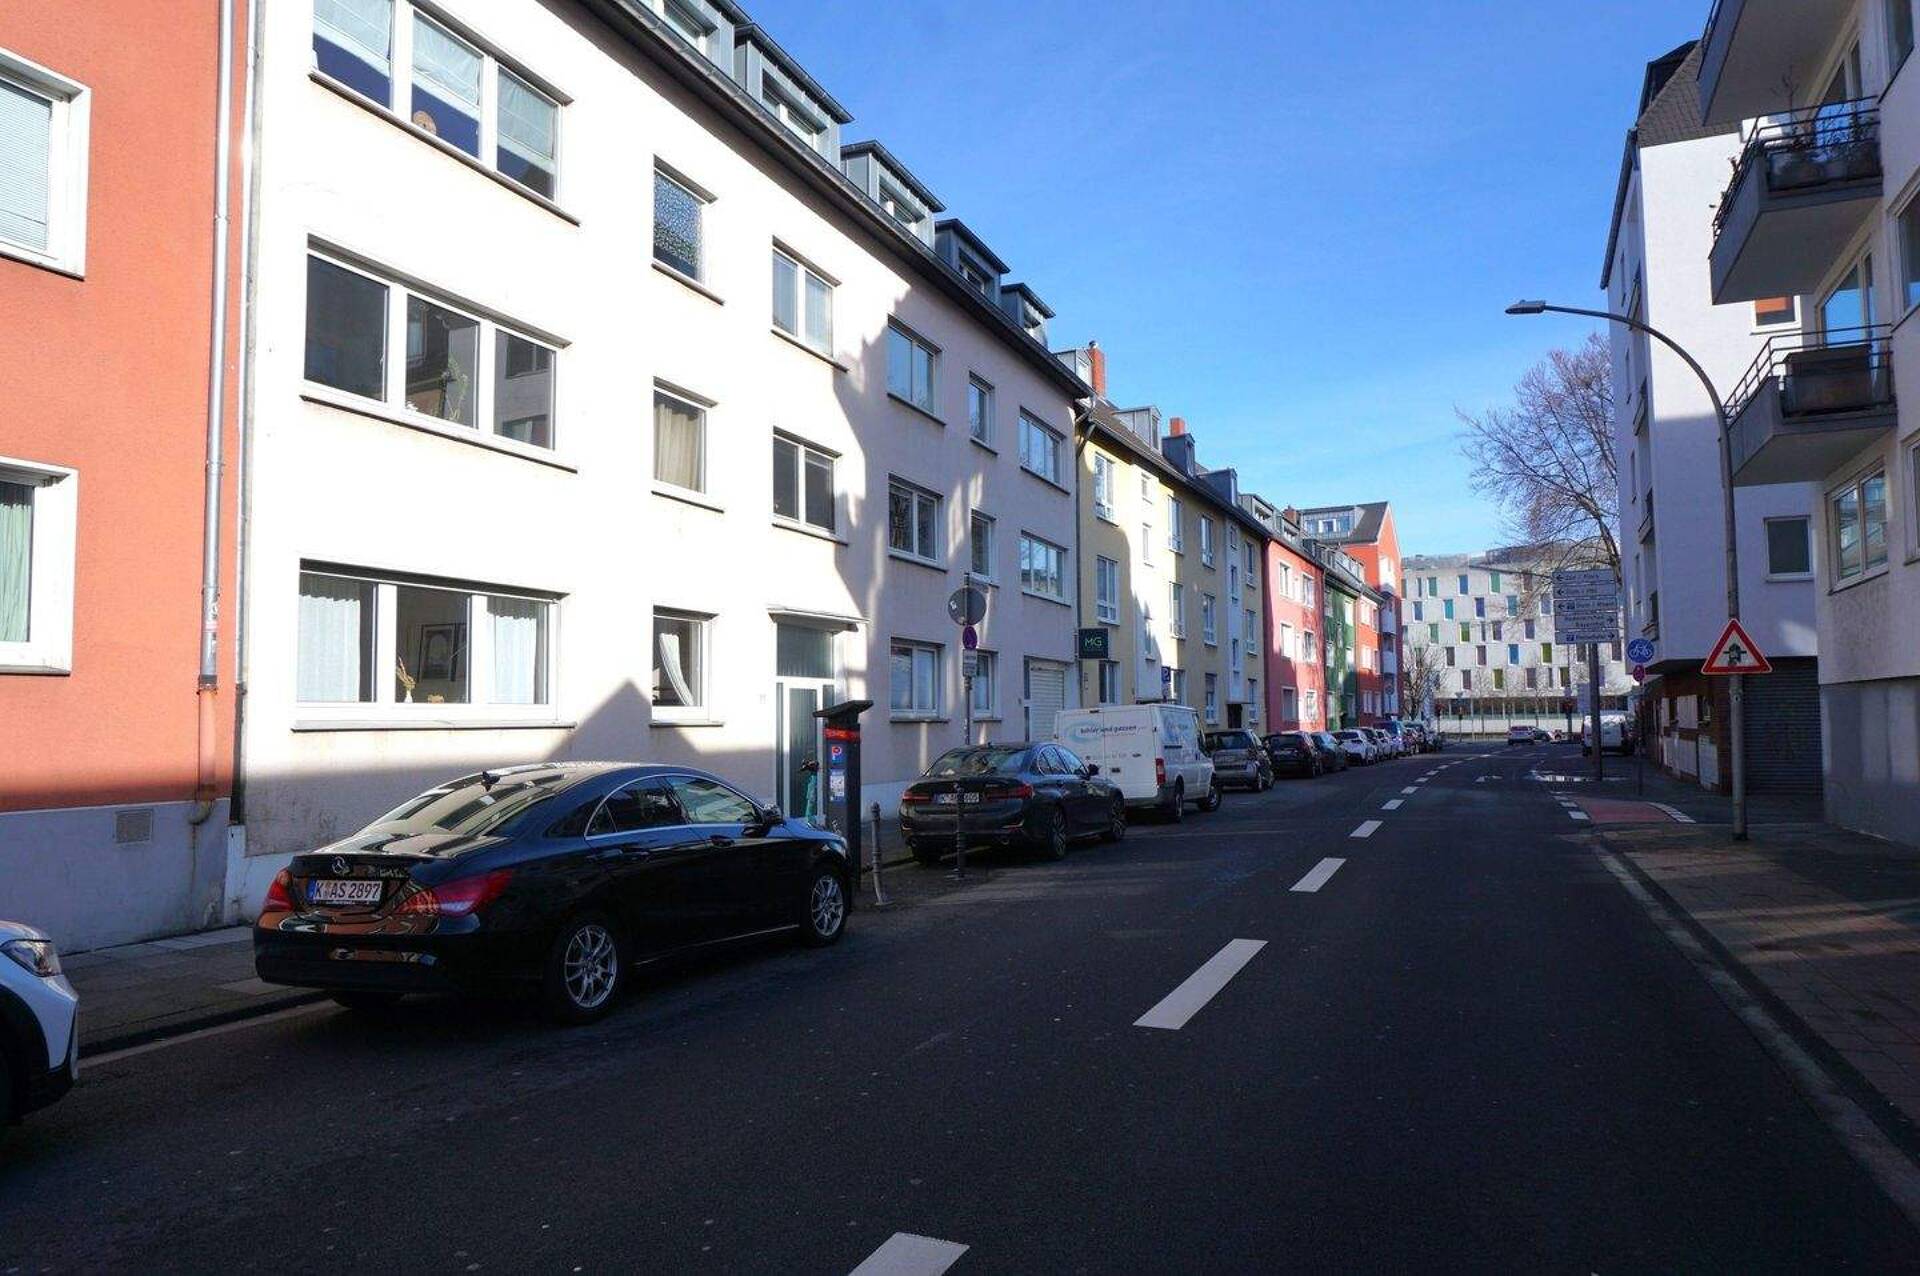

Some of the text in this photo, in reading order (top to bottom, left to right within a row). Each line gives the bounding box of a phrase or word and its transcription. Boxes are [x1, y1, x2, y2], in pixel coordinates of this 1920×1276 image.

[314, 882, 381, 899] K AS 2897
